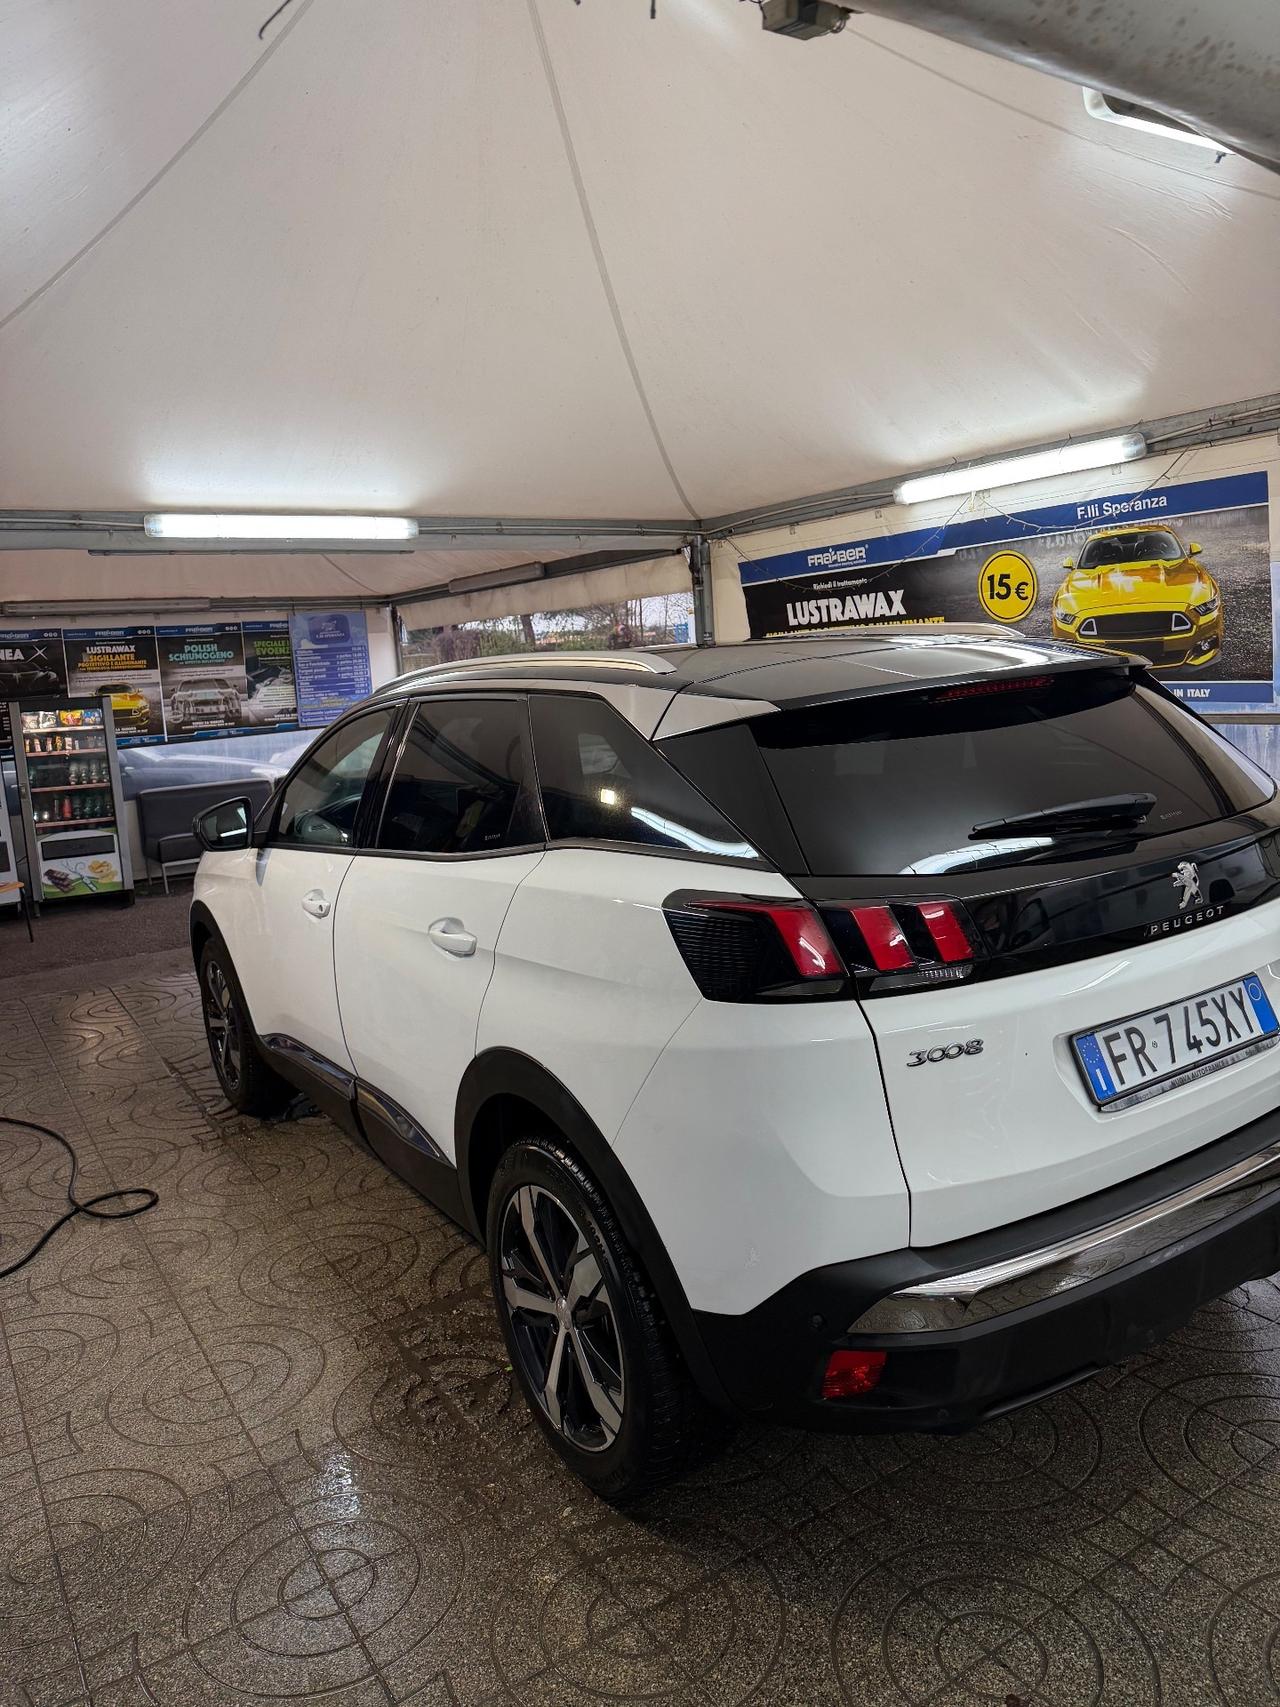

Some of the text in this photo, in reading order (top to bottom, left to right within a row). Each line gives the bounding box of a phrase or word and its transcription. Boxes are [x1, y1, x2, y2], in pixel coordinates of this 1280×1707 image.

[1103, 495, 1167, 516] Speranza
[987, 574, 1029, 601] 15 €
[786, 589, 907, 626] LUSTRAWAX
[86, 645, 136, 654] LUSTRAWAX
[184, 643, 218, 653] POLISH
[89, 653, 135, 662] SIGILLANTE
[168, 651, 234, 662] SCHIUMOGENO
[1173, 688, 1211, 698] IN ITALY
[1149, 905, 1224, 936] PEUGEOT
[906, 1038, 984, 1067] 3008
[1096, 1068, 1107, 1091] I
[1171, 1075, 1192, 1087] NUOVA
